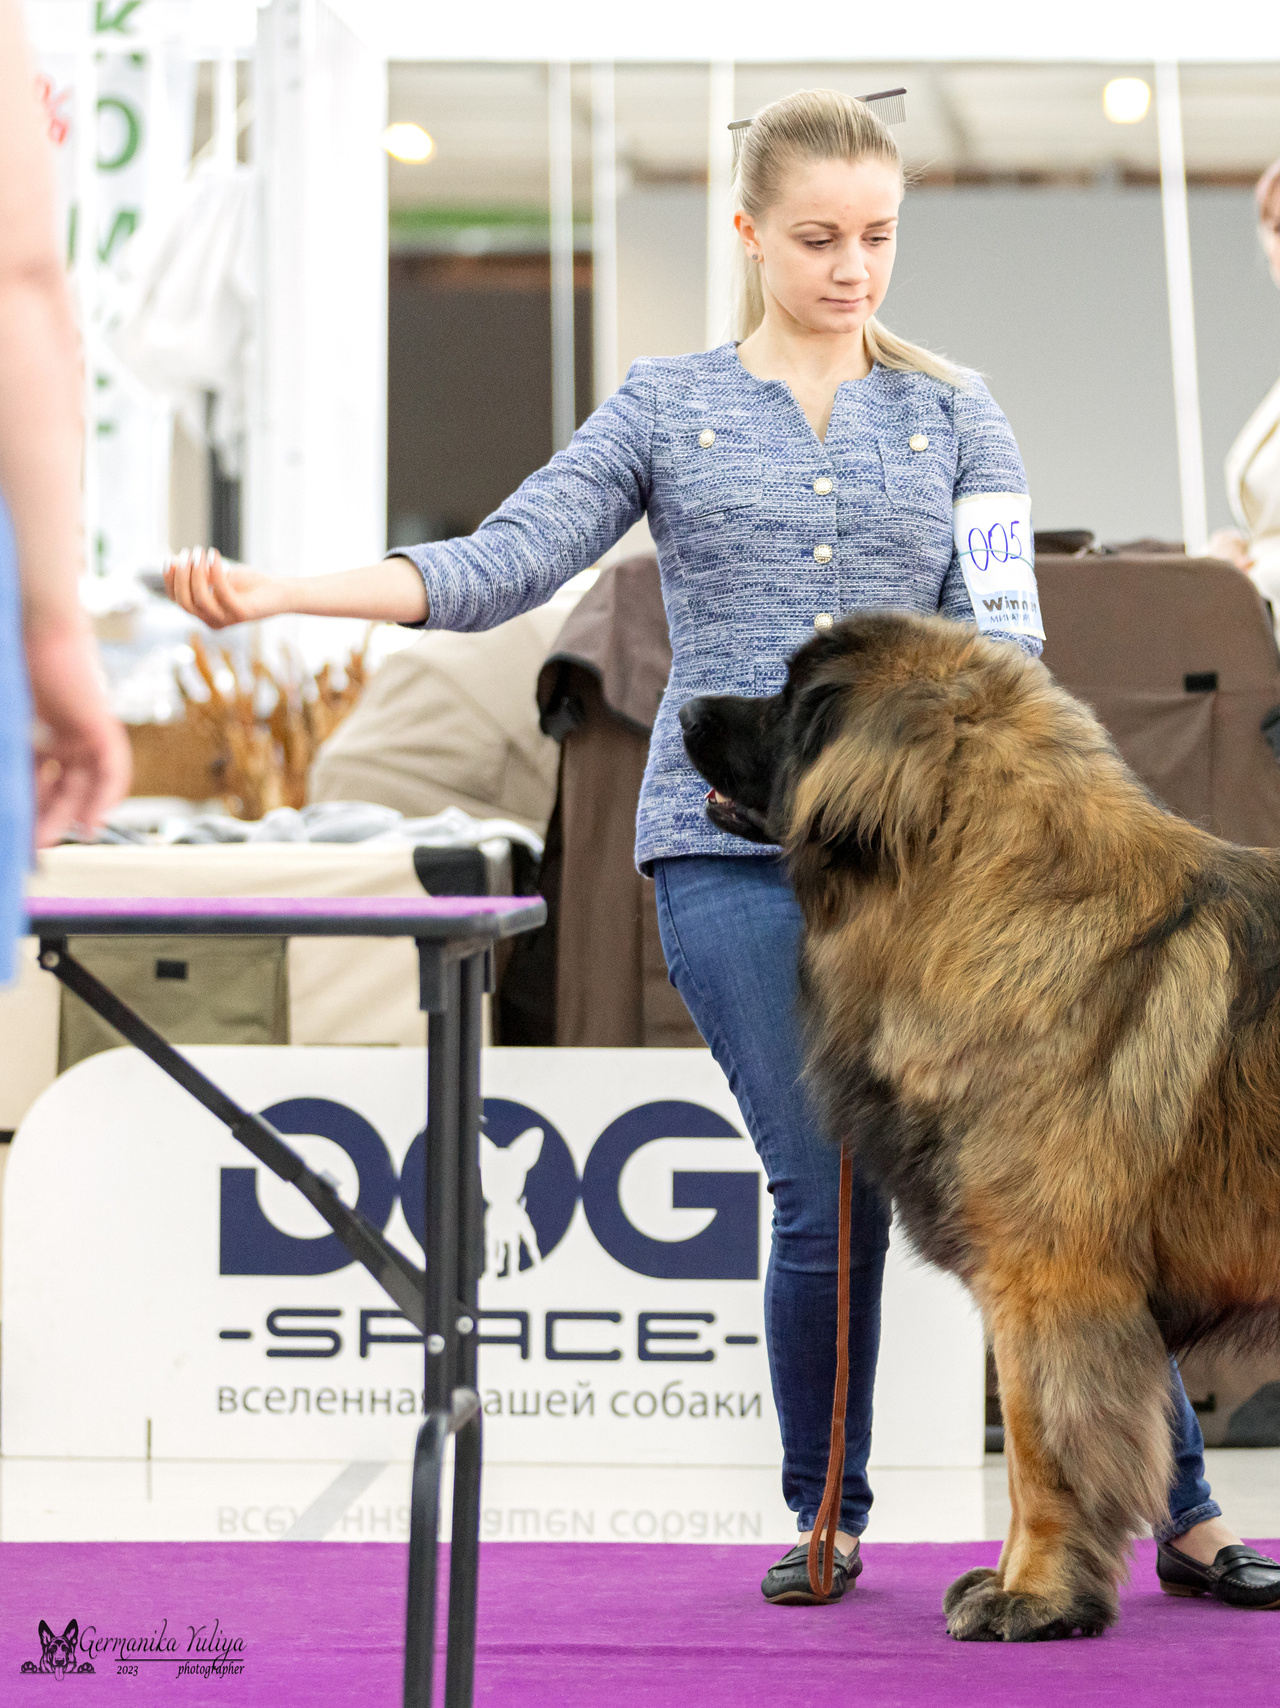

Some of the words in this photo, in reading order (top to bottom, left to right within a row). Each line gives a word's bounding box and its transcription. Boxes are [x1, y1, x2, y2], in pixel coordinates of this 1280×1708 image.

[968, 520, 1022, 571] 005
[219, 1096, 761, 1280] DOG
[217, 1386, 426, 1415] вселенна
[483, 1379, 596, 1417] ашей
[610, 1379, 763, 1418] собаки
